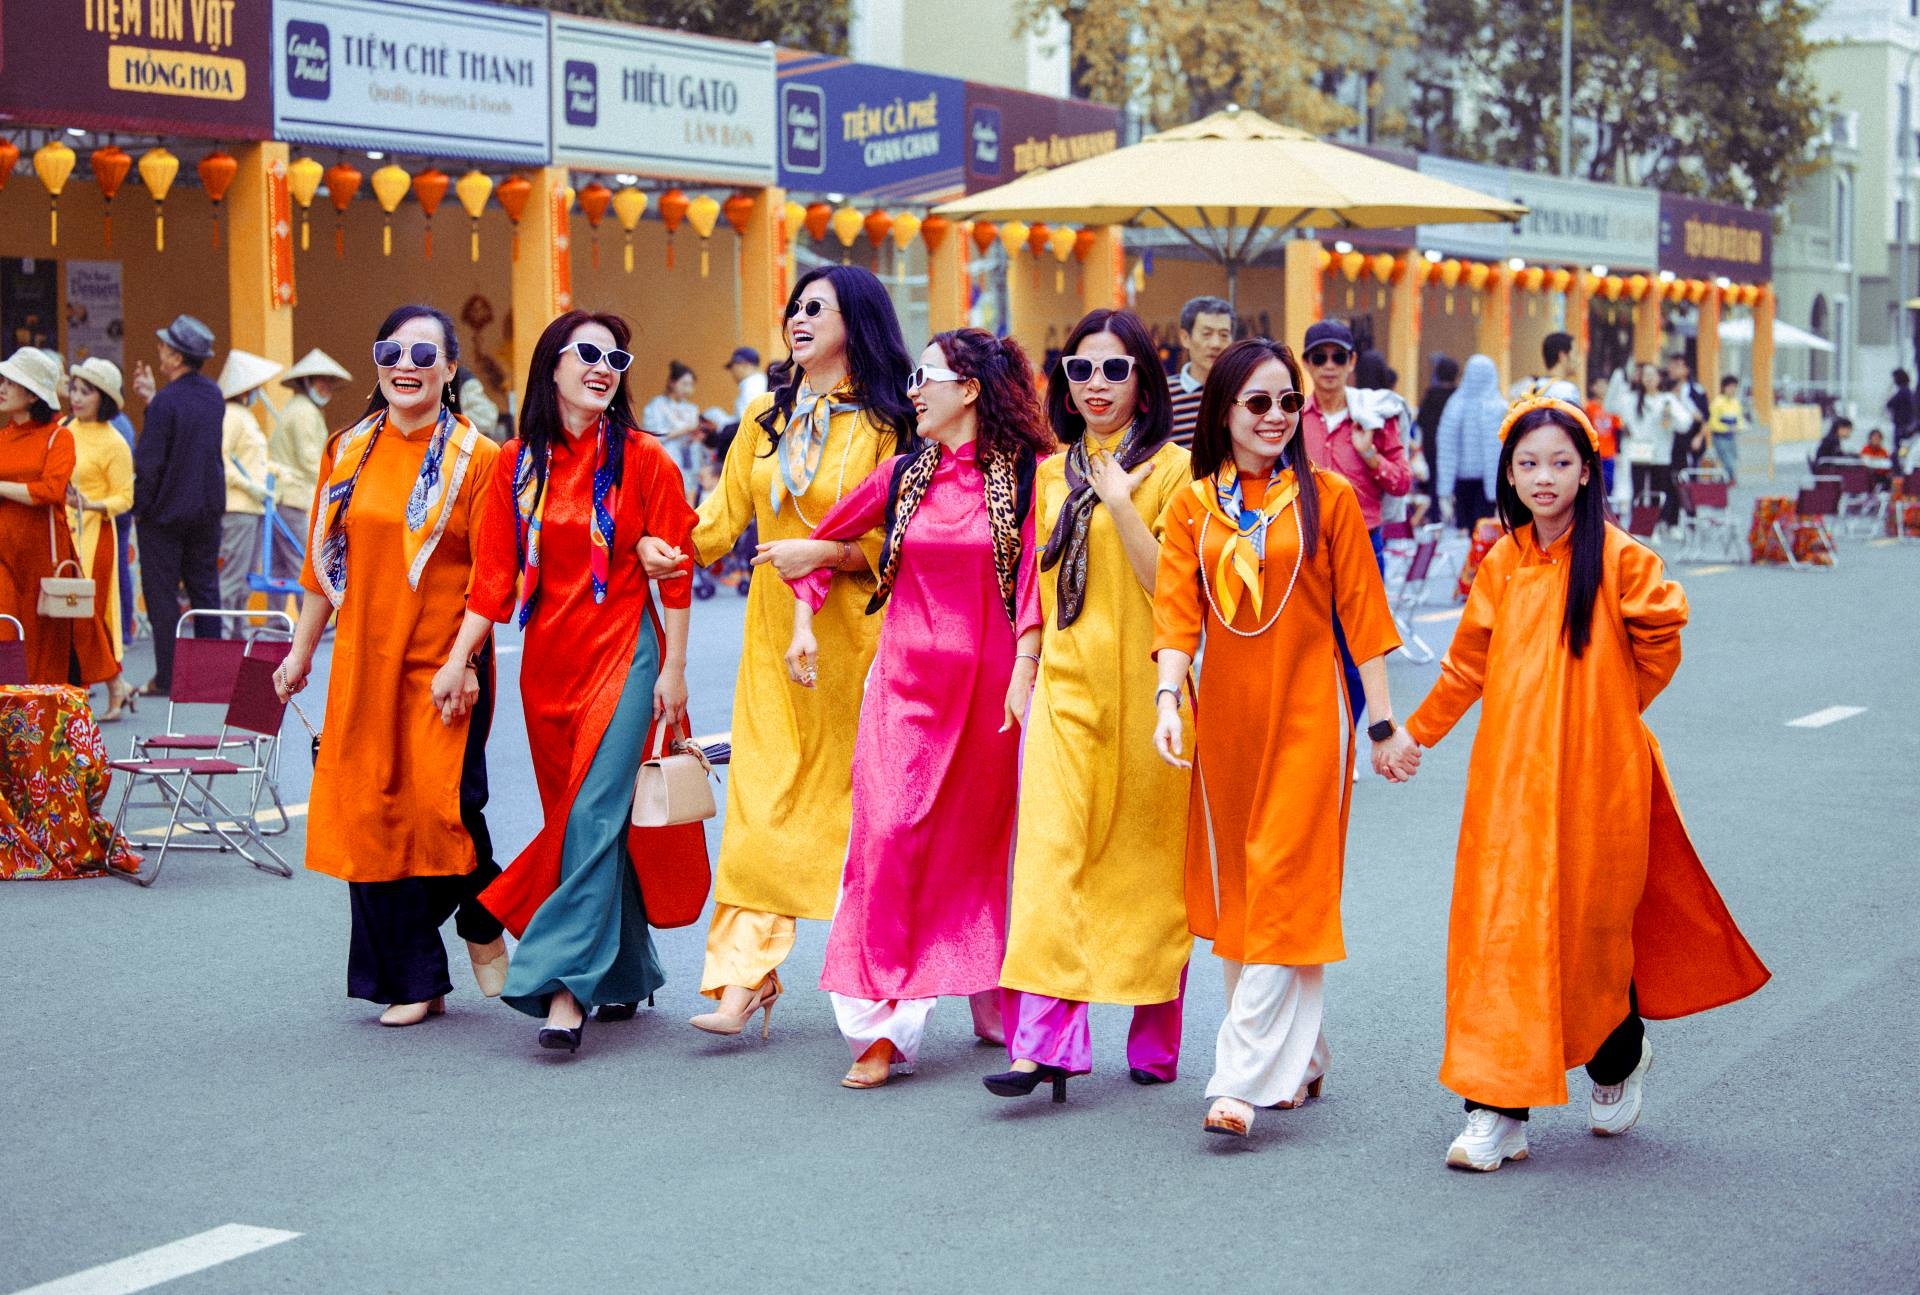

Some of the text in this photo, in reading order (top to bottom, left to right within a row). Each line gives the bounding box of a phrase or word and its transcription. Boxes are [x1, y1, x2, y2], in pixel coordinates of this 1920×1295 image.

[190, 65, 234, 93] HOA
[342, 33, 397, 74] TIỆM
[458, 50, 535, 88] THANH
[622, 64, 674, 111] HIỆU
[678, 75, 738, 115] GATO
[842, 102, 882, 145] TIỆM
